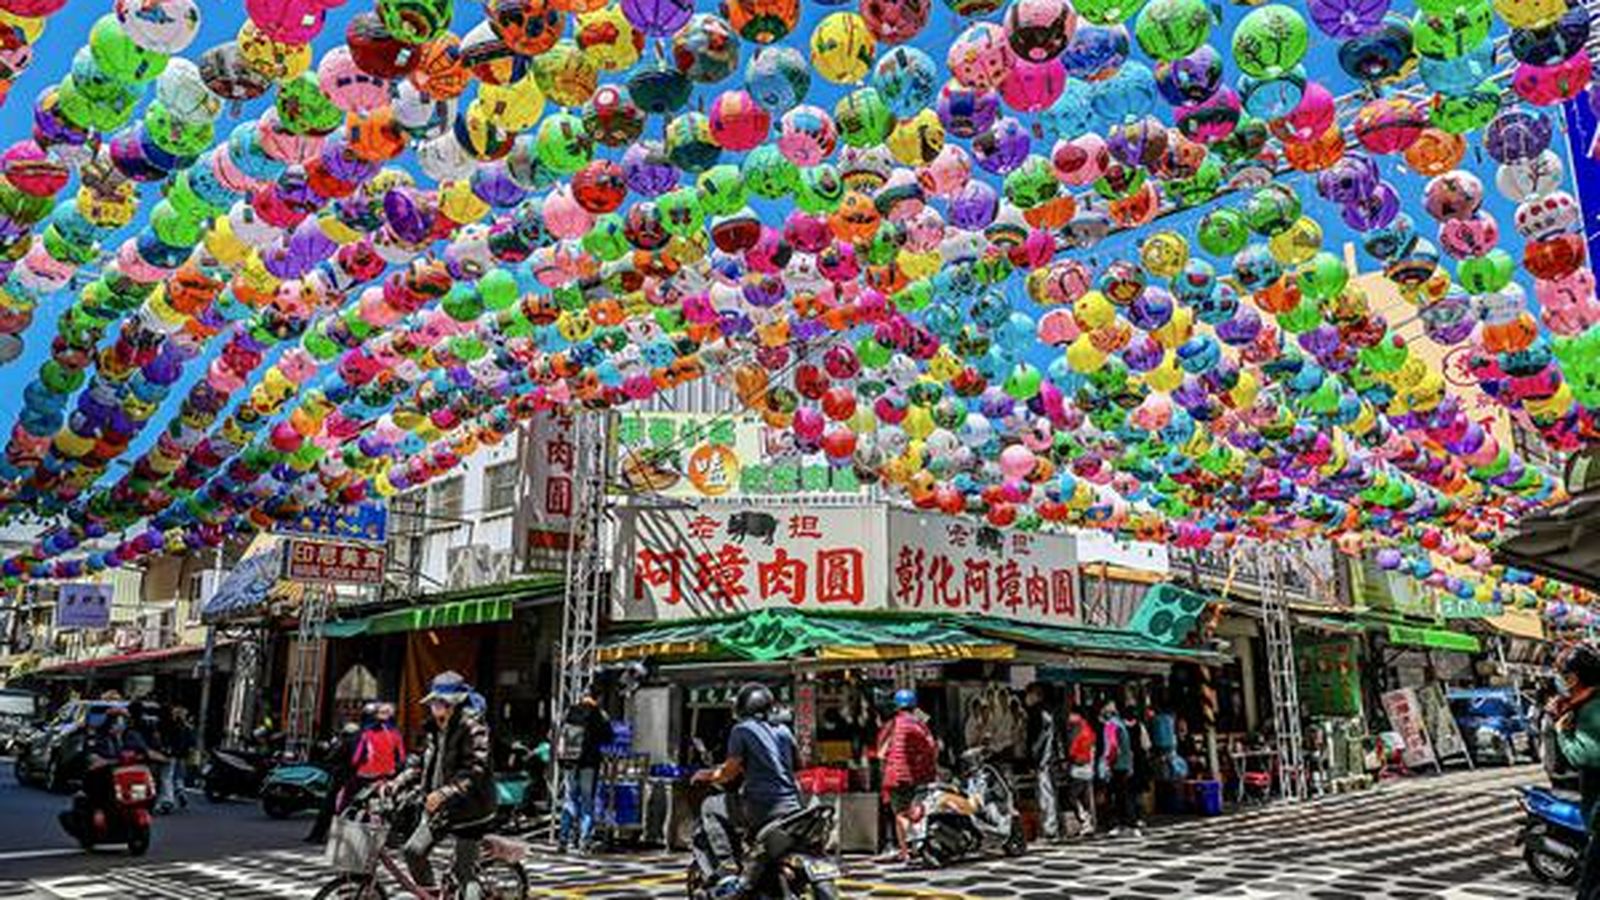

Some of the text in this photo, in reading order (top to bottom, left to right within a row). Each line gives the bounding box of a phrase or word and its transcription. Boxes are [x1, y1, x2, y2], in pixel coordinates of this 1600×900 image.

[687, 513, 823, 539] 老 担
[633, 543, 865, 607] 阿璋肉圓
[895, 544, 1075, 617] 彰化阿璋肉圓
